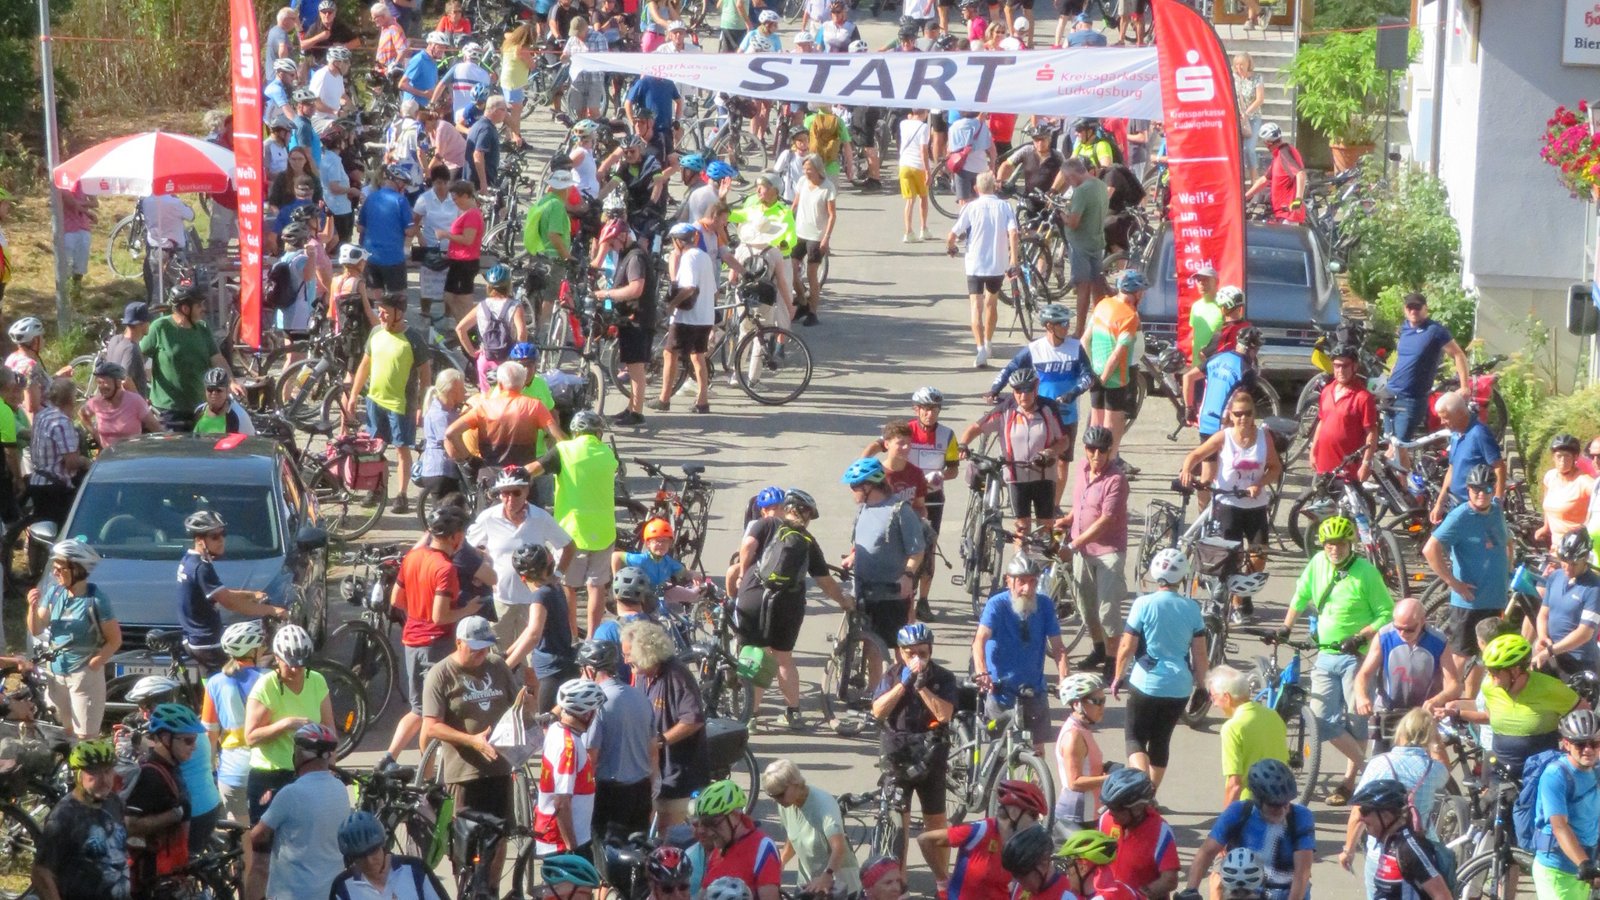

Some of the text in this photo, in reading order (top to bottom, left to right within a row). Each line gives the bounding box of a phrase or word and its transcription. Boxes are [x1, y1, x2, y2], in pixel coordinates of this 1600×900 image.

[739, 56, 1017, 103] START
[1057, 86, 1143, 100] Ludwigsburg
[1169, 108, 1225, 119] Kreissparkasse
[1174, 119, 1223, 129] Ludwigsburg
[1178, 192, 1215, 204] Weil's
[1180, 211, 1198, 221] um
[1181, 226, 1213, 238] mehr
[1184, 241, 1200, 254] als
[1185, 258, 1213, 271] Geld
